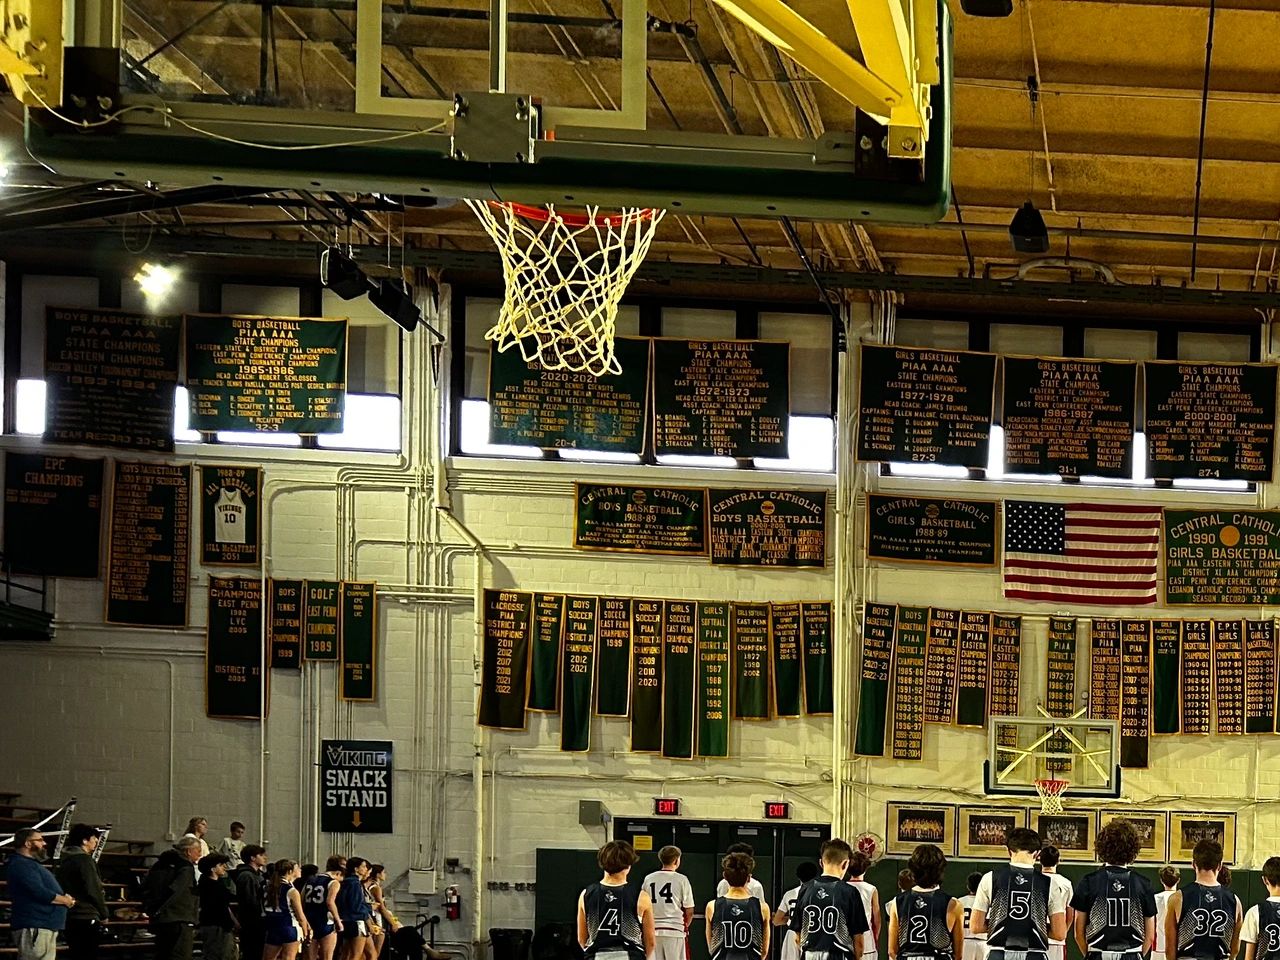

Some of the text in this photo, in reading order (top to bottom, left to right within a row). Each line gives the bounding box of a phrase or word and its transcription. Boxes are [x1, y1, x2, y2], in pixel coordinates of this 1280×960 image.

[257, 321, 300, 330] BASKETBALL
[272, 330, 293, 338] AAA
[261, 338, 299, 347] CHAMPIONS
[239, 366, 294, 374] 1985-1986
[695, 388, 749, 396] 1972-1973
[901, 392, 953, 402] 1977-1978
[1044, 410, 1093, 418] 1986-1987
[1185, 412, 1236, 421] 2000-2001
[582, 488, 699, 511] CENTRAL CATHOLIC
[713, 492, 821, 514] CENTRAL CATHOLIC
[599, 502, 682, 515] BOYS BASKETBALL
[876, 500, 989, 523] CENTRAL CATHOLIC
[224, 514, 235, 523] 10
[625, 513, 656, 522] 1988-89
[747, 515, 822, 523] BASKETBALL
[888, 515, 976, 529] GIRLS BASKETBALL
[1170, 514, 1224, 538] CENTRAL
[916, 528, 948, 537] 1988-89
[1189, 534, 1268, 545] 1990 1991
[1170, 548, 1203, 558] GIRLS
[1168, 559, 1181, 567] PIAA
[1187, 559, 1197, 567] AAA
[1236, 560, 1253, 568] STATE
[1170, 577, 1185, 585] EAST
[1191, 577, 1207, 585] PENN
[1212, 577, 1251, 585] CONFERENCE
[311, 588, 334, 599] GOLF
[1197, 586, 1222, 594] CATHOLIC
[1227, 586, 1256, 594] CHRISTMAS
[573, 601, 589, 609] BOYS
[311, 641, 331, 651] 1989
[571, 655, 587, 663] 2012
[327, 748, 386, 766] VIKING
[326, 770, 387, 787] SNACK
[326, 790, 387, 807] STAND
[659, 801, 675, 812] EXIT
[769, 805, 784, 816] EXIT
[305, 885, 325, 903] 23
[650, 883, 672, 904] 14
[1009, 891, 1031, 919] 5
[1107, 898, 1131, 927] 11
[598, 908, 620, 936] 4
[804, 905, 840, 934] 30
[1193, 908, 1229, 937] 32
[722, 920, 751, 948] 10
[910, 916, 927, 943] 2
